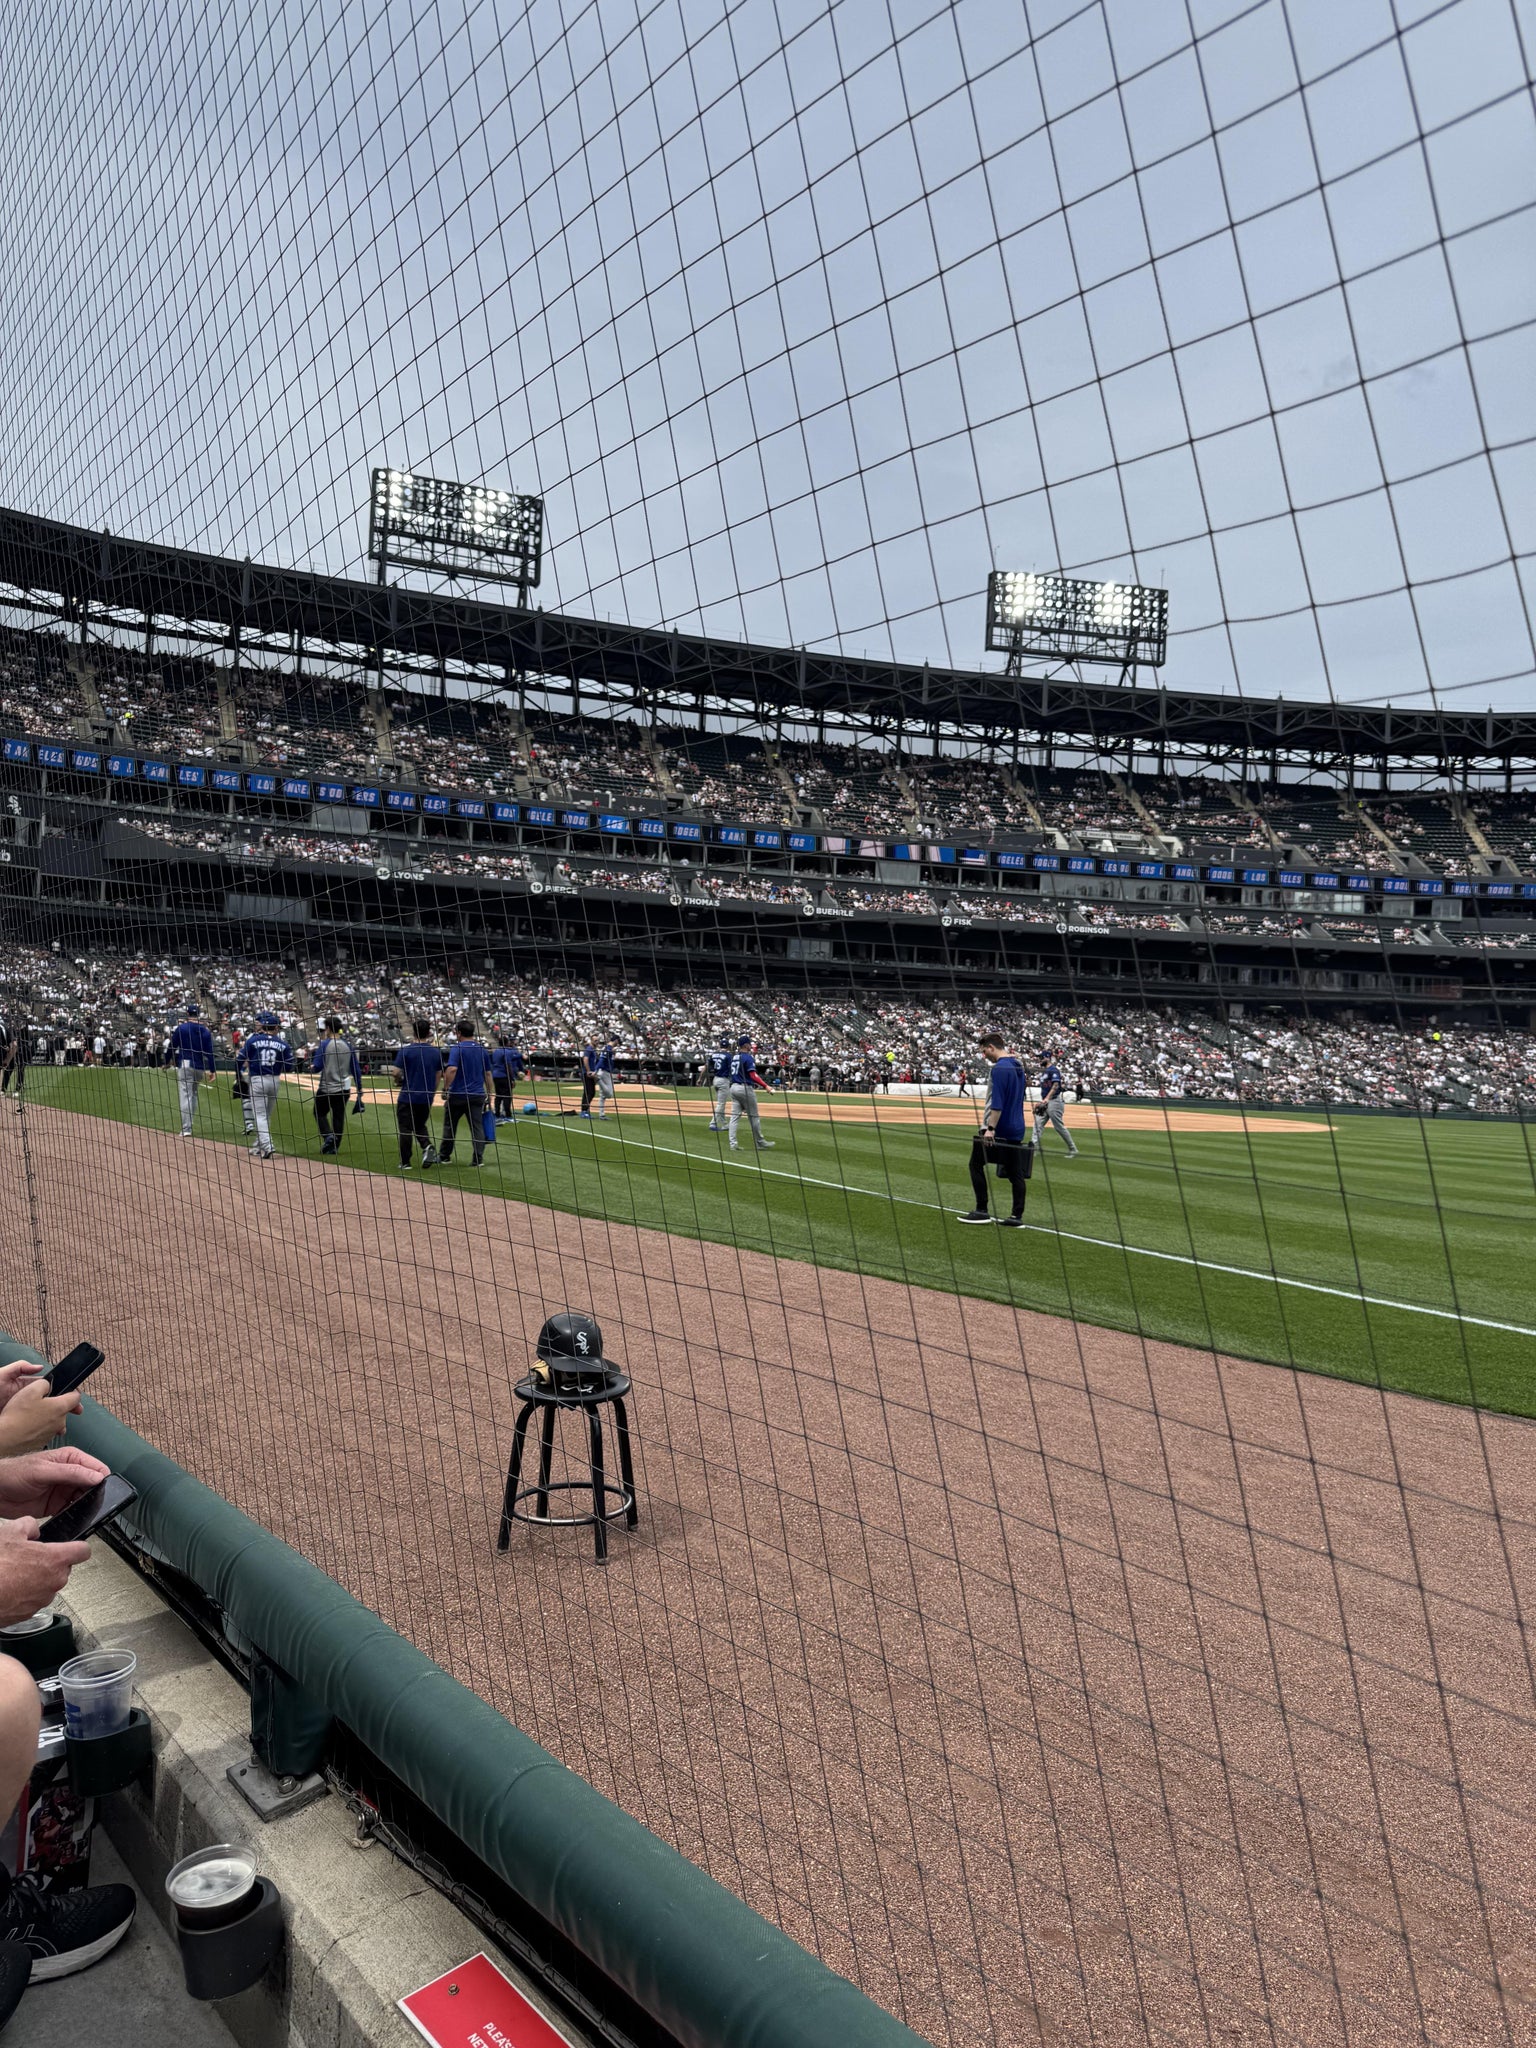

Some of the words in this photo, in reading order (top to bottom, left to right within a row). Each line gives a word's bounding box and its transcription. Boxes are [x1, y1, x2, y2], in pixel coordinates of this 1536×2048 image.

[393, 871, 425, 881] LYONS
[683, 897, 720, 907] THOMAS
[816, 907, 855, 917] BUEHRLE
[954, 918, 972, 926] FISK
[1068, 926, 1110, 935] ROBINSON
[483, 2022, 516, 2048] PLEAS
